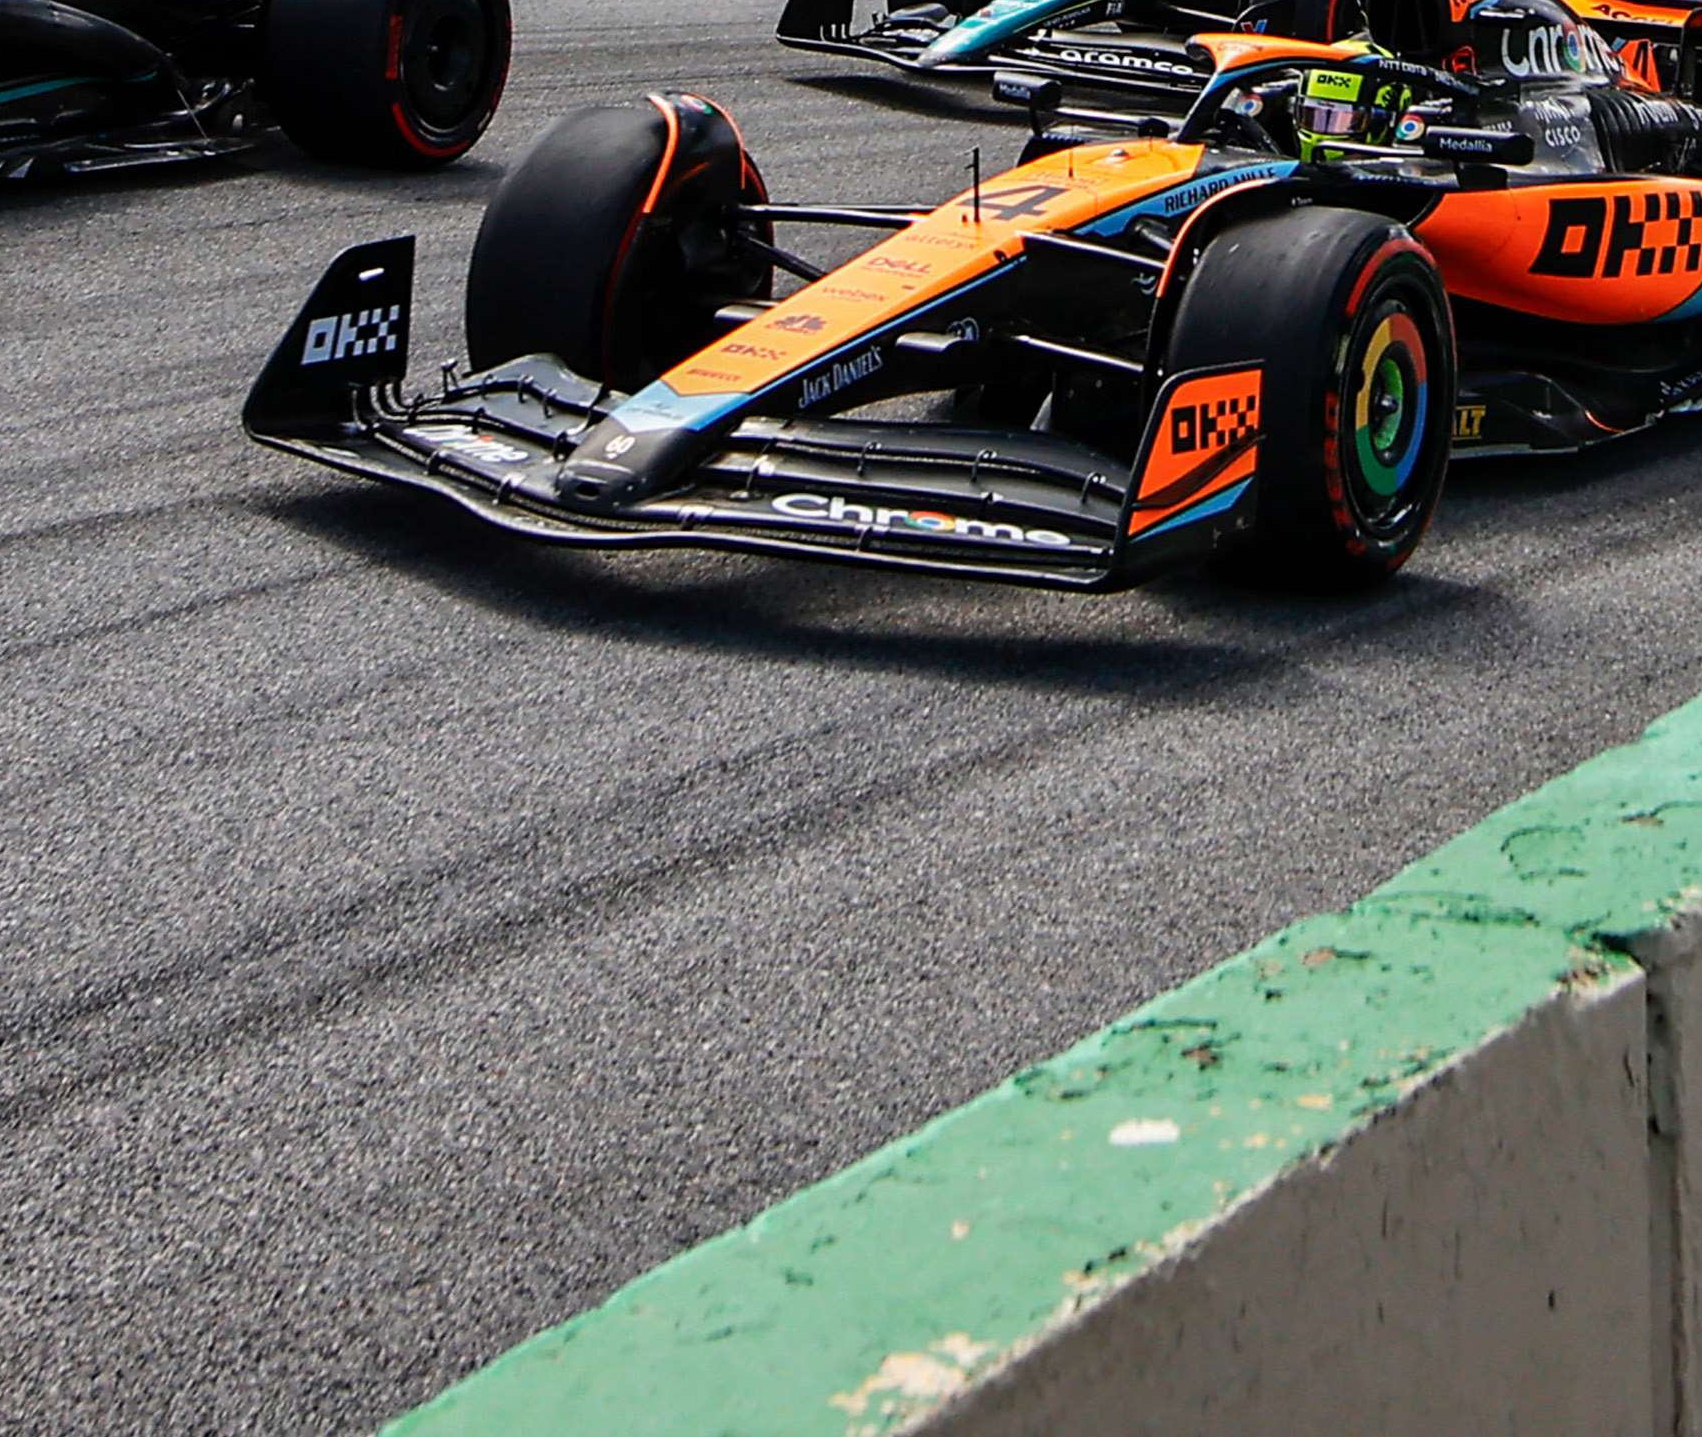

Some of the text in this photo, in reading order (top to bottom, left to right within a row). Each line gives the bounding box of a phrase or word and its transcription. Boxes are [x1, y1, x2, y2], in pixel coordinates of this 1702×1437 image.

[1059, 49, 1194, 75] aramco
[1315, 72, 1351, 88] OKX
[1439, 136, 1493, 152] Medallia
[1544, 123, 1581, 148] CISCO
[1163, 179, 1229, 214] RICHARD
[301, 305, 401, 365] OKX
[798, 373, 831, 410] JACK
[1170, 395, 1257, 455] OKX
